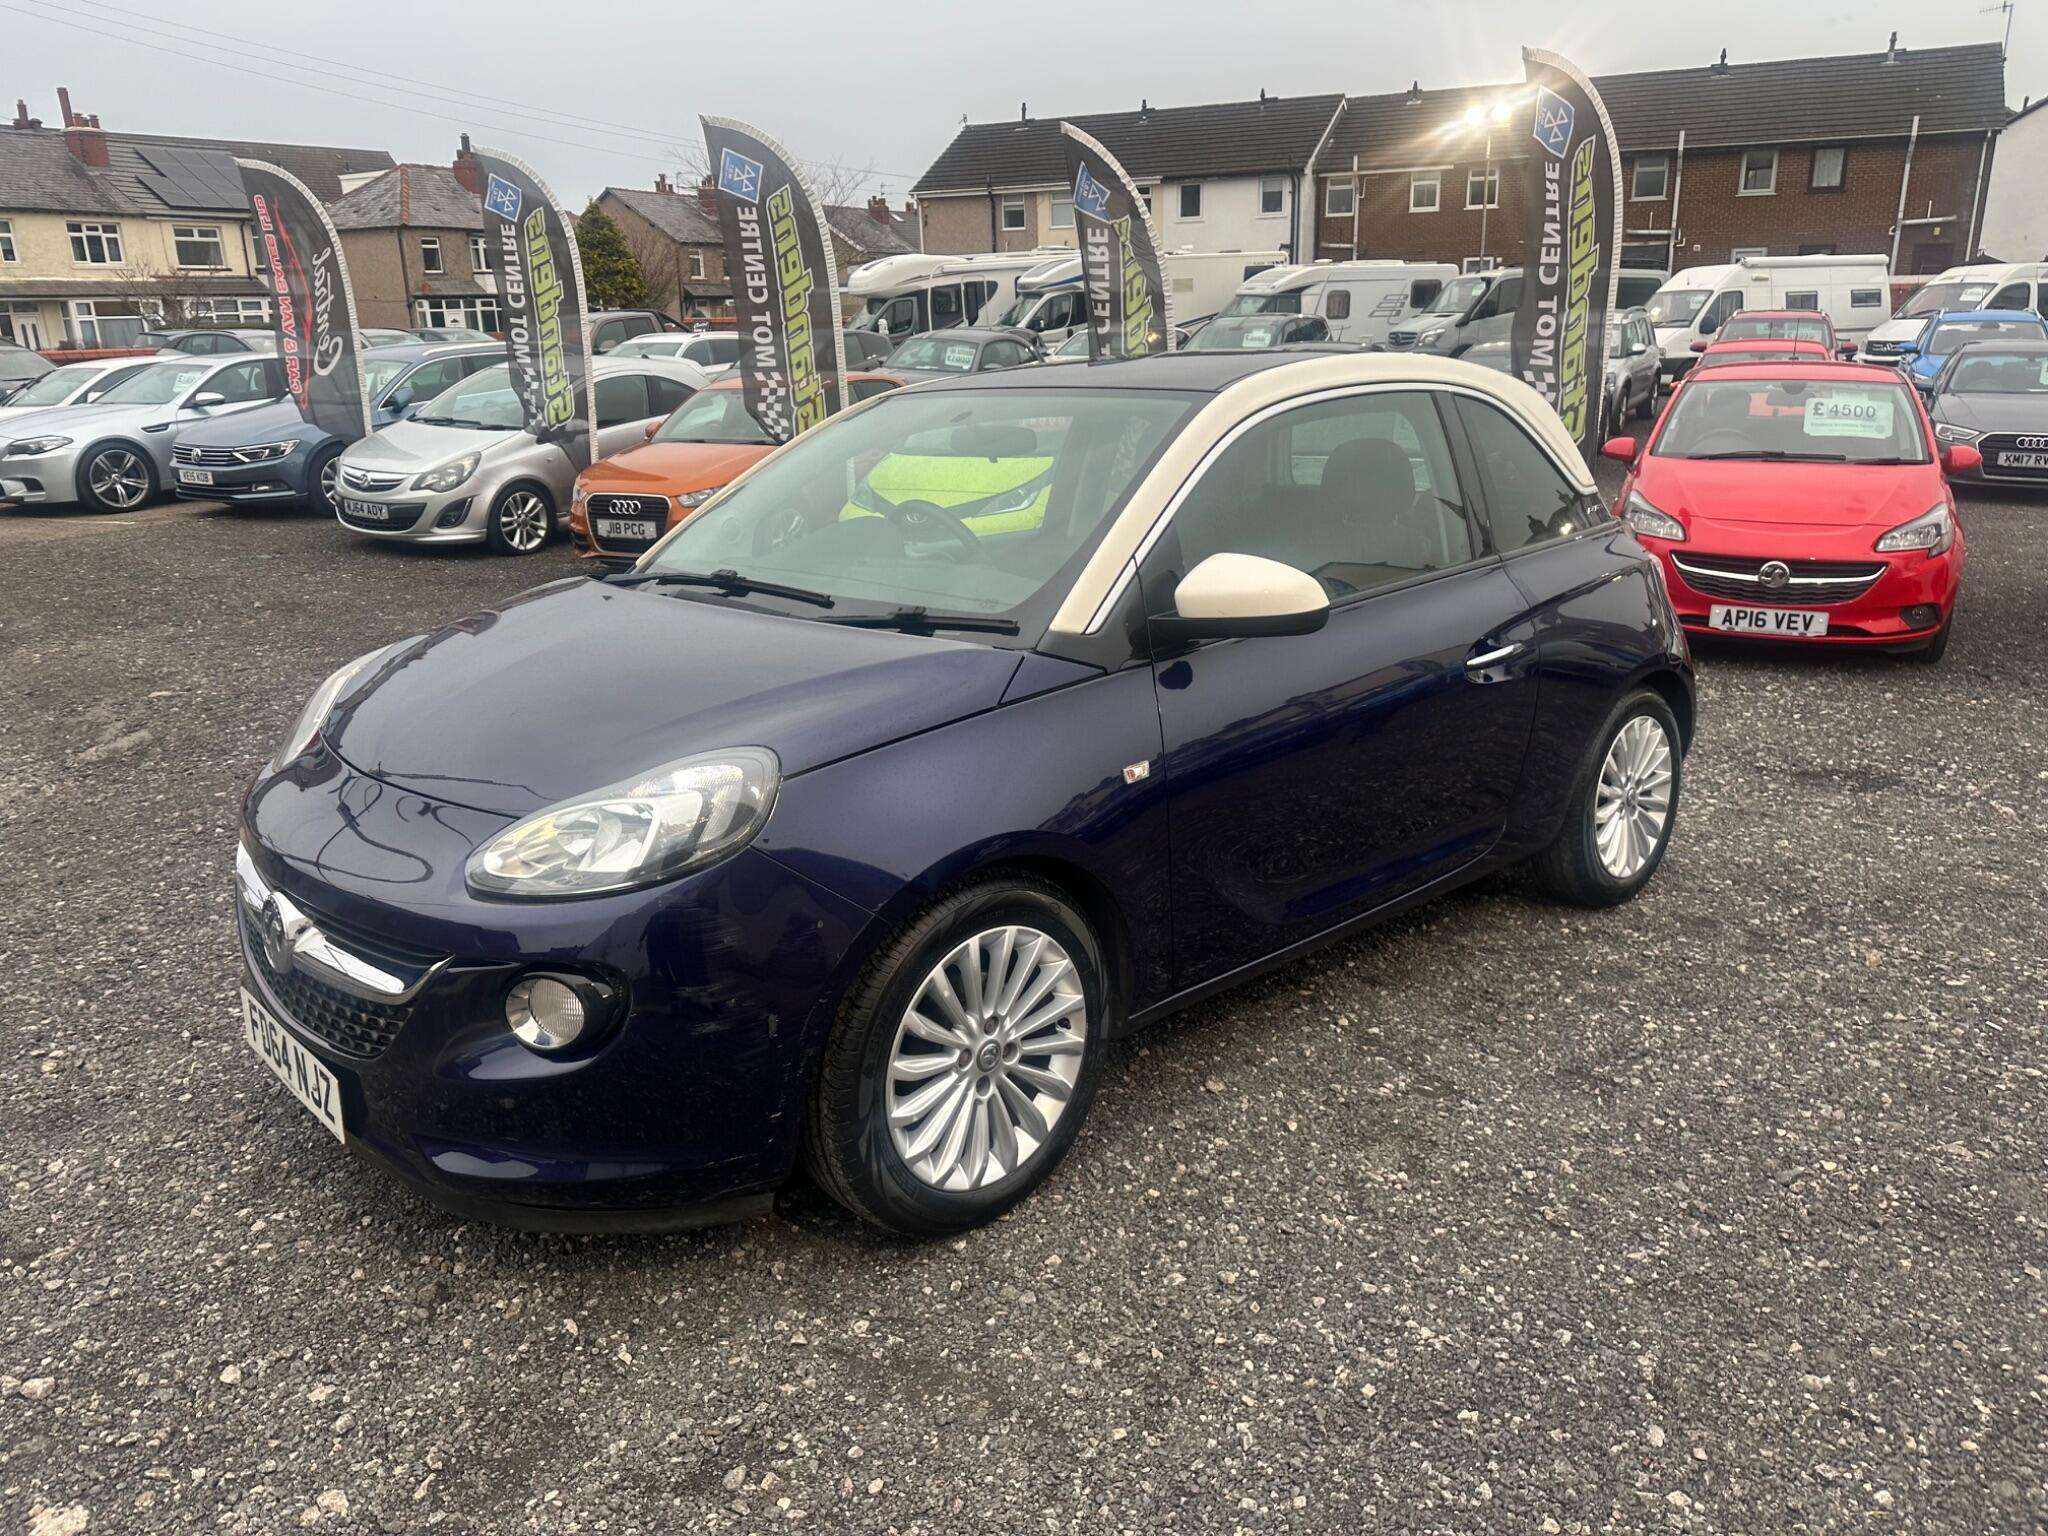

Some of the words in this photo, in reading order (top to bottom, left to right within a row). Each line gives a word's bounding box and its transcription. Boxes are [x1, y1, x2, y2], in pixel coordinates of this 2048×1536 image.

[2004, 453, 2031, 465] KM17
[607, 521, 621, 534] J18
[624, 522, 645, 536] PCG
[1721, 608, 1767, 628] AP16
[1774, 611, 1814, 631] VEV
[248, 999, 292, 1081] FD64
[293, 1044, 336, 1126] NJZ
